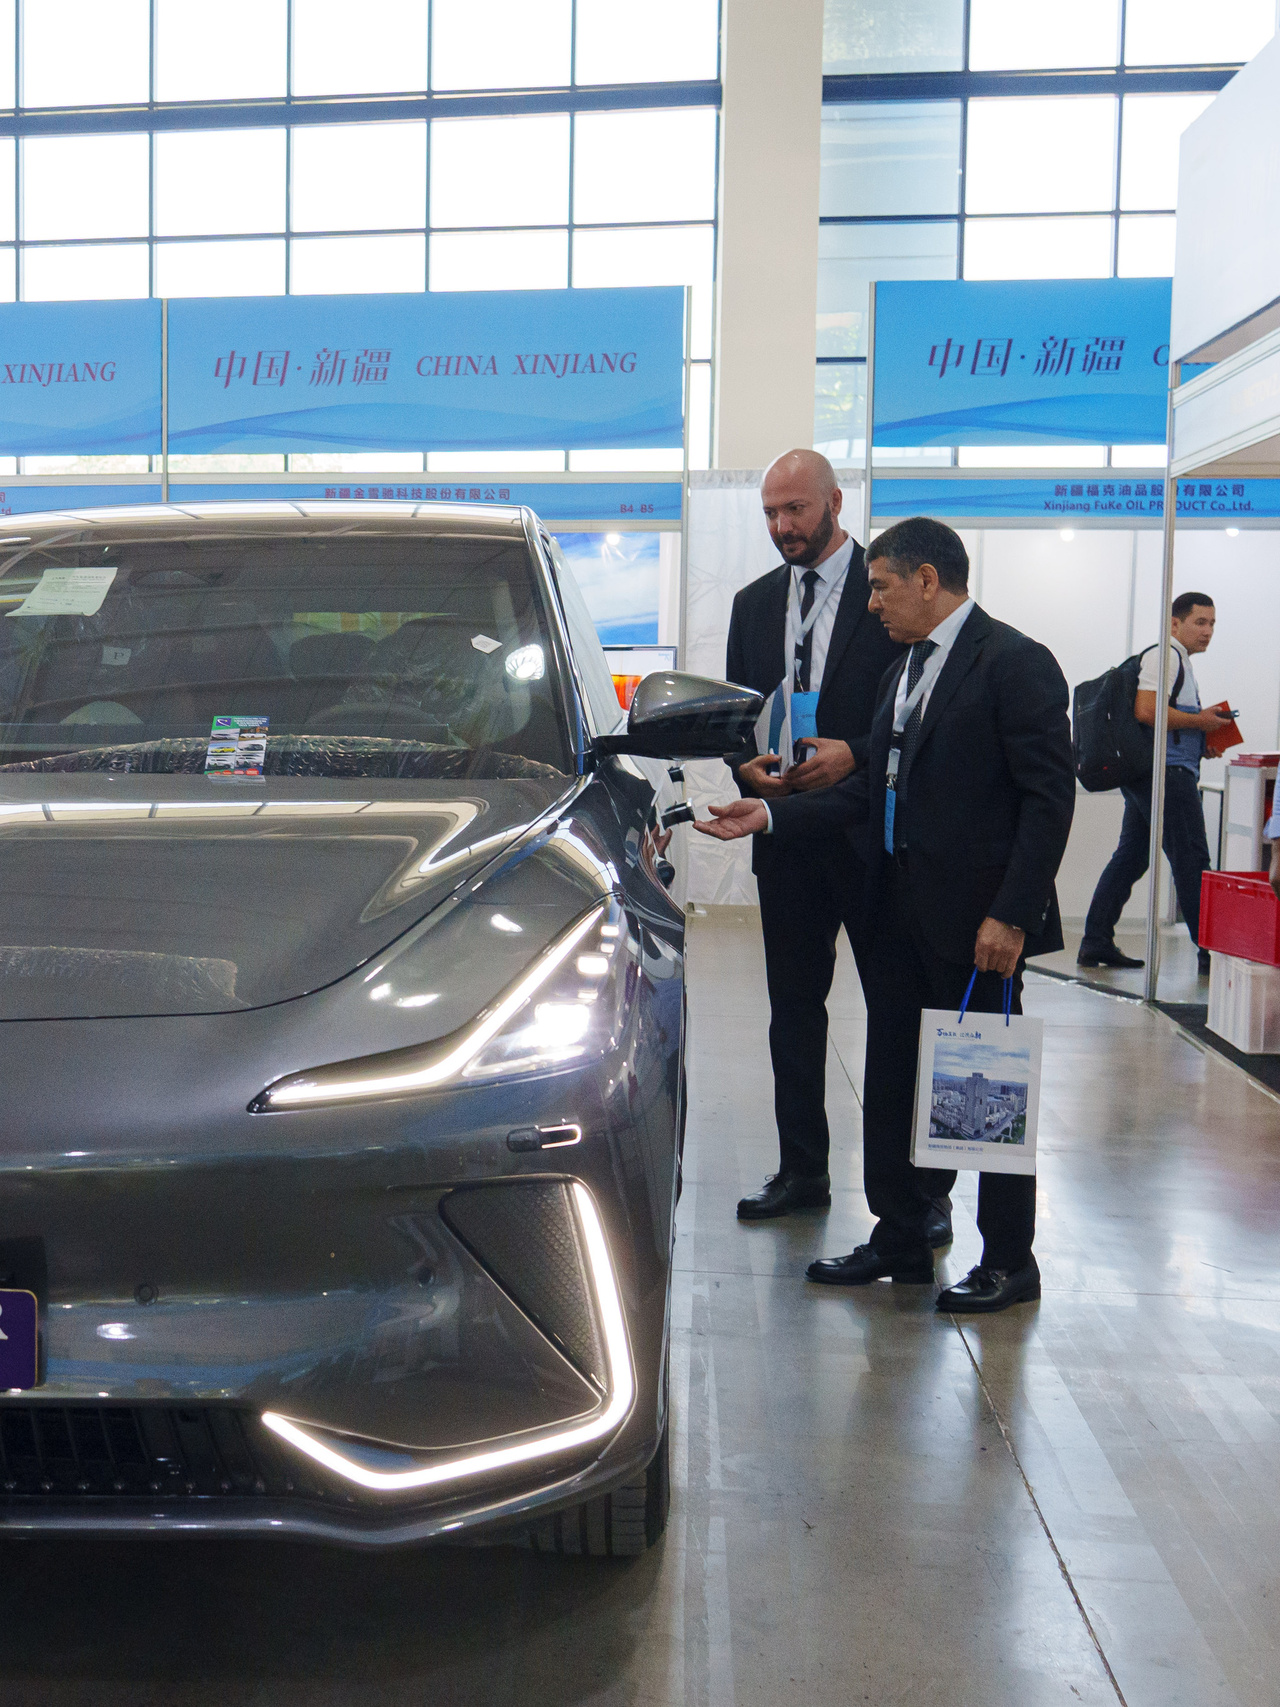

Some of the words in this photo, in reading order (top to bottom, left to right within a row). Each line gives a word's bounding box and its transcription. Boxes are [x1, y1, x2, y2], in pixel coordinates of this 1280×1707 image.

[213, 347, 393, 389] 中国·新疆
[415, 355, 499, 377] CHINA
[512, 352, 637, 378] XINJIANG
[928, 335, 1127, 379] 中国·新疆
[1, 361, 116, 387] XINJIANG
[1055, 484, 1244, 497] 新疆福克油品股有限公司
[1044, 501, 1090, 512] Xinjiang
[1094, 500, 1122, 510] FuKe
[1126, 500, 1145, 510] OIL
[1149, 501, 1206, 510] PRDUCT
